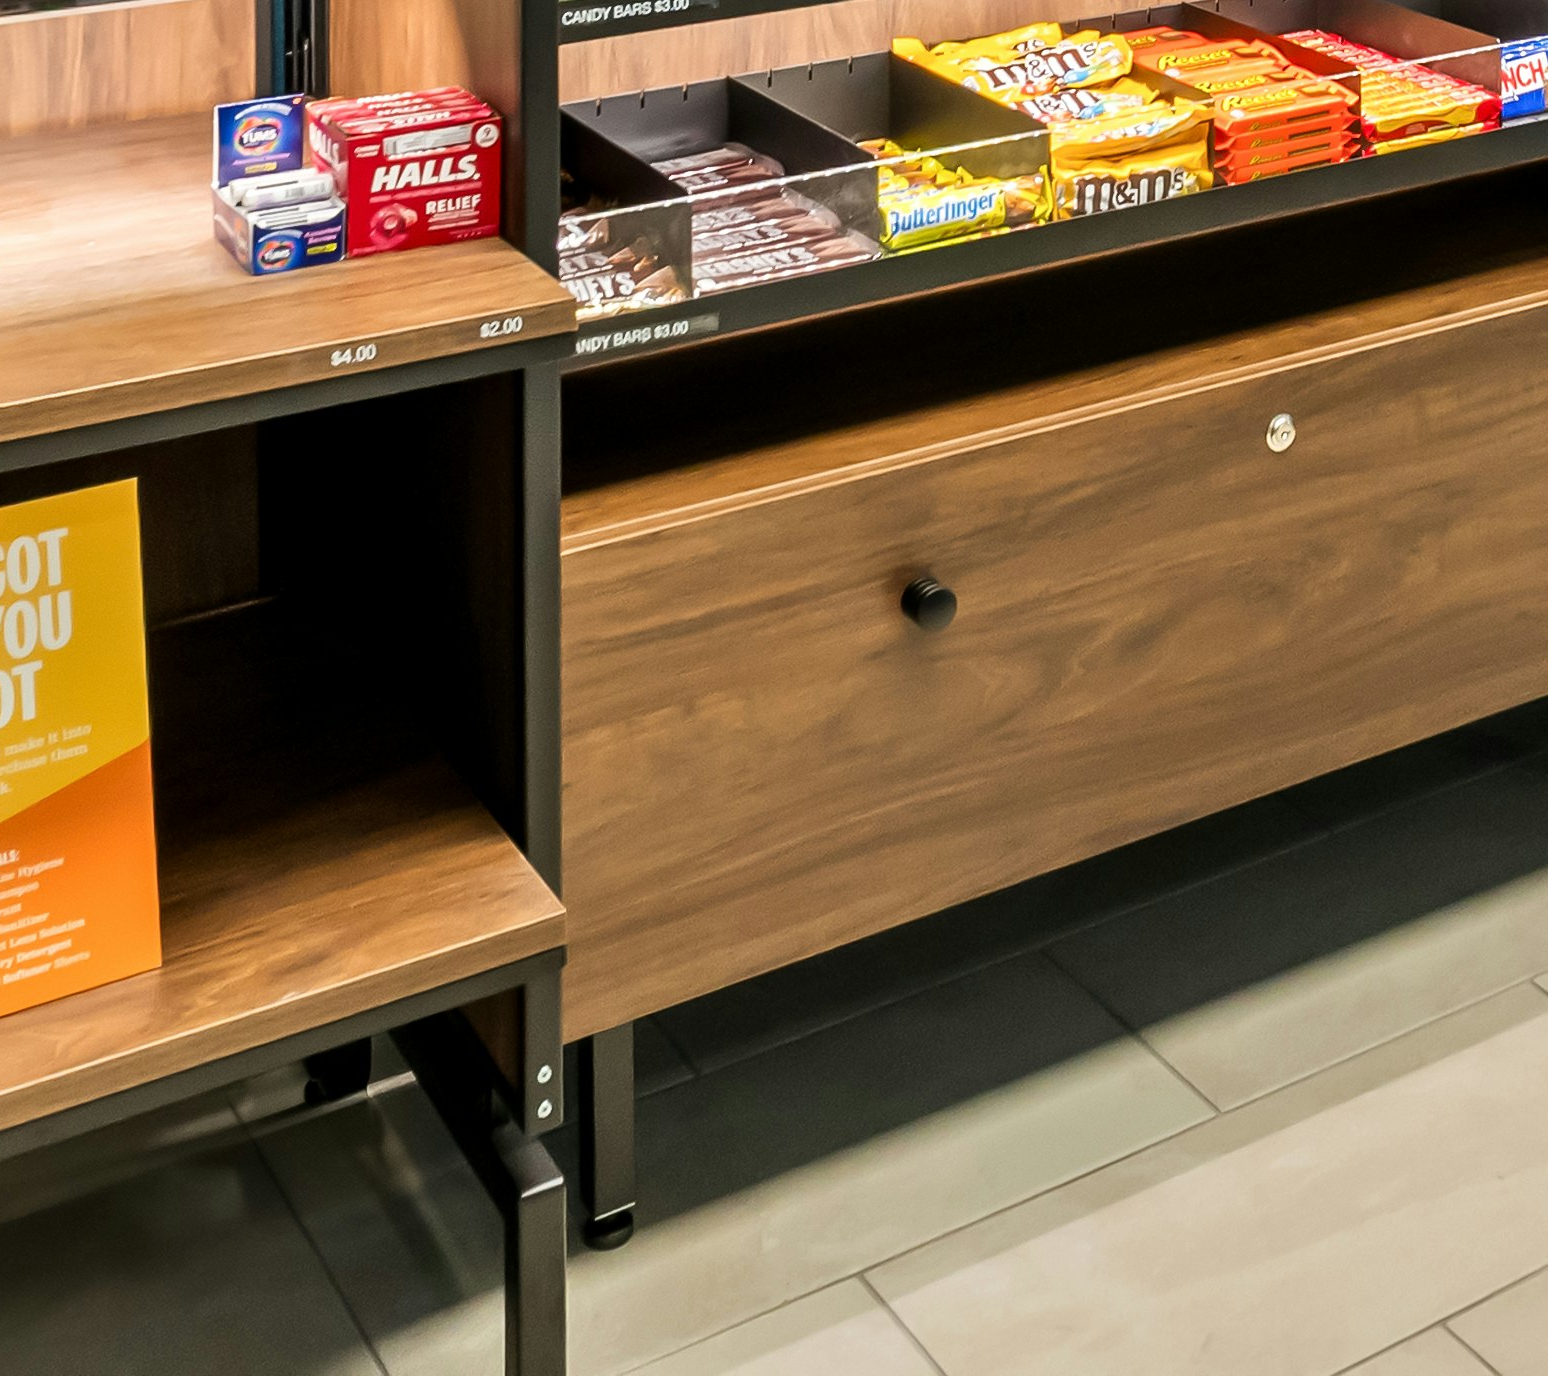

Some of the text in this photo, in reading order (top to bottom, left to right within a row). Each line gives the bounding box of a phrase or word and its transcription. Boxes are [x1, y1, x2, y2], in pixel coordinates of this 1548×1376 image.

[562, 6, 612, 26] CANDY
[613, 1, 651, 18] BARS
[984, 42, 1097, 88] m&m's
[1159, 48, 1231, 70] Reese's
[242, 127, 278, 147] TUMS
[425, 194, 481, 215] RELIEF
[890, 191, 996, 236] Butterfinger
[480, 316, 522, 338] $2.00
[331, 344, 377, 366] $4.00
[4, 738, 44, 756] make
[48, 731, 58, 744] it
[51, 744, 88, 762] them
